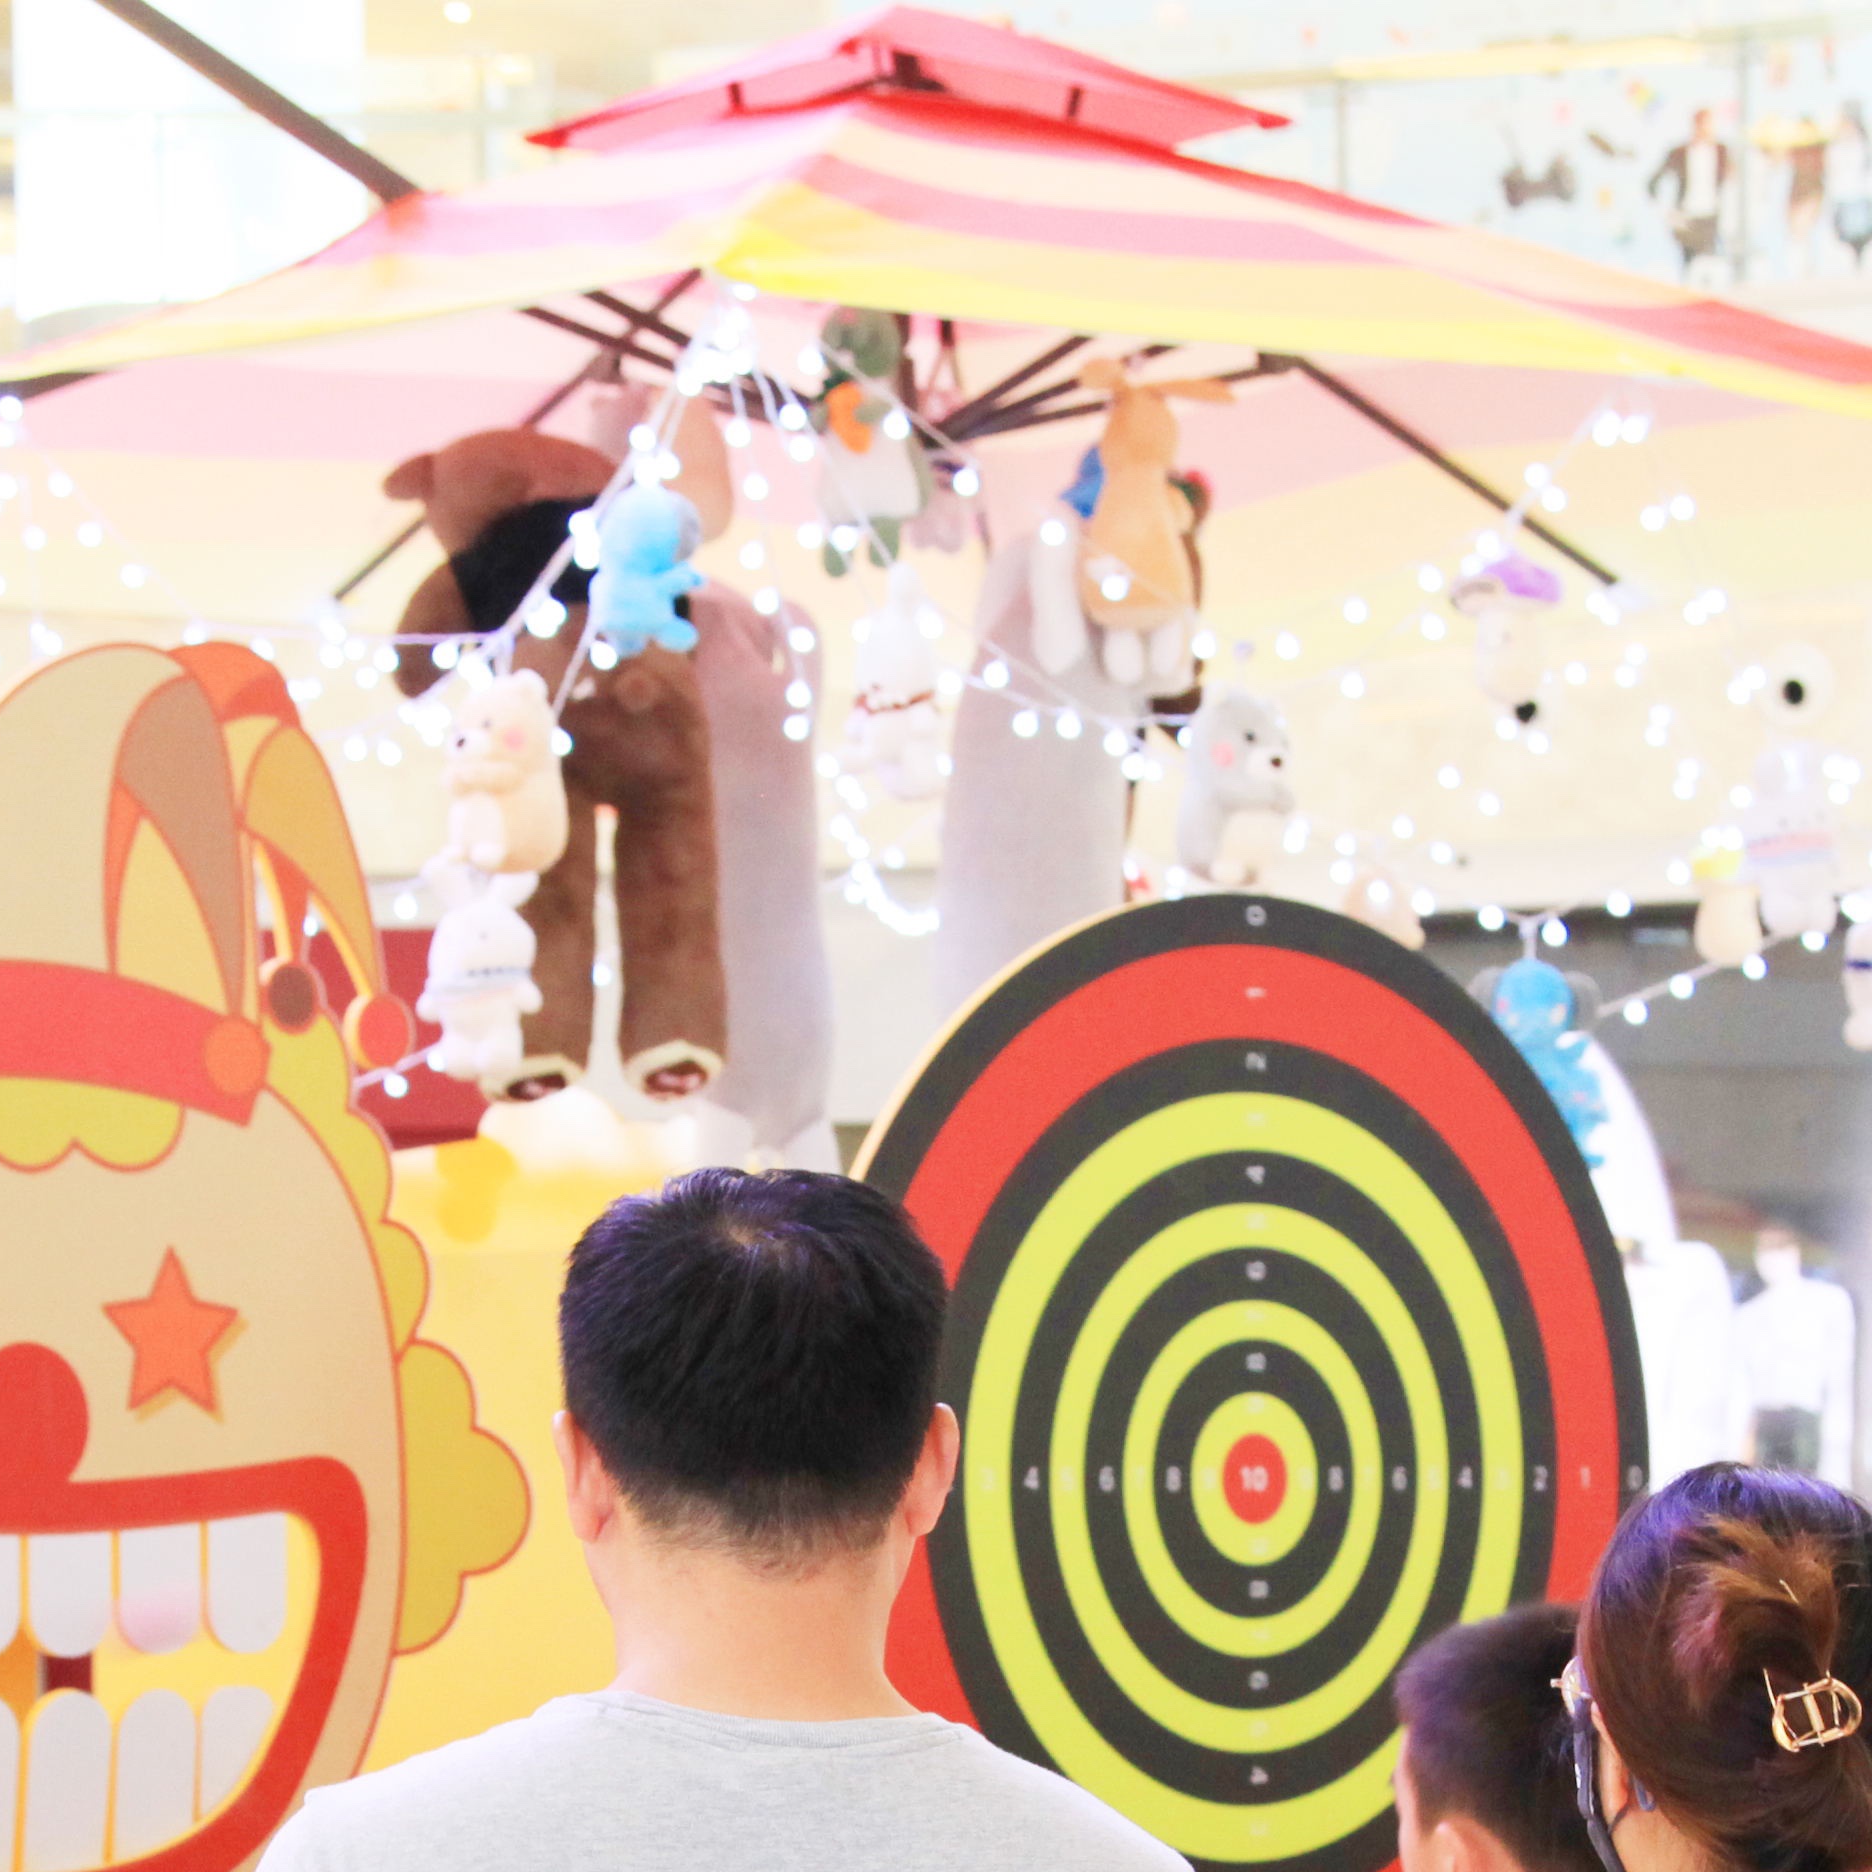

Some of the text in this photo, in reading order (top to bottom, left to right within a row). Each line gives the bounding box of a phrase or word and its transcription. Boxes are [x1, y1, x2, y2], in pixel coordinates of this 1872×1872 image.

[1023, 1466, 1040, 1490] 4
[1240, 1465, 1269, 1492] 10
[1458, 1466, 1473, 1489] 4
